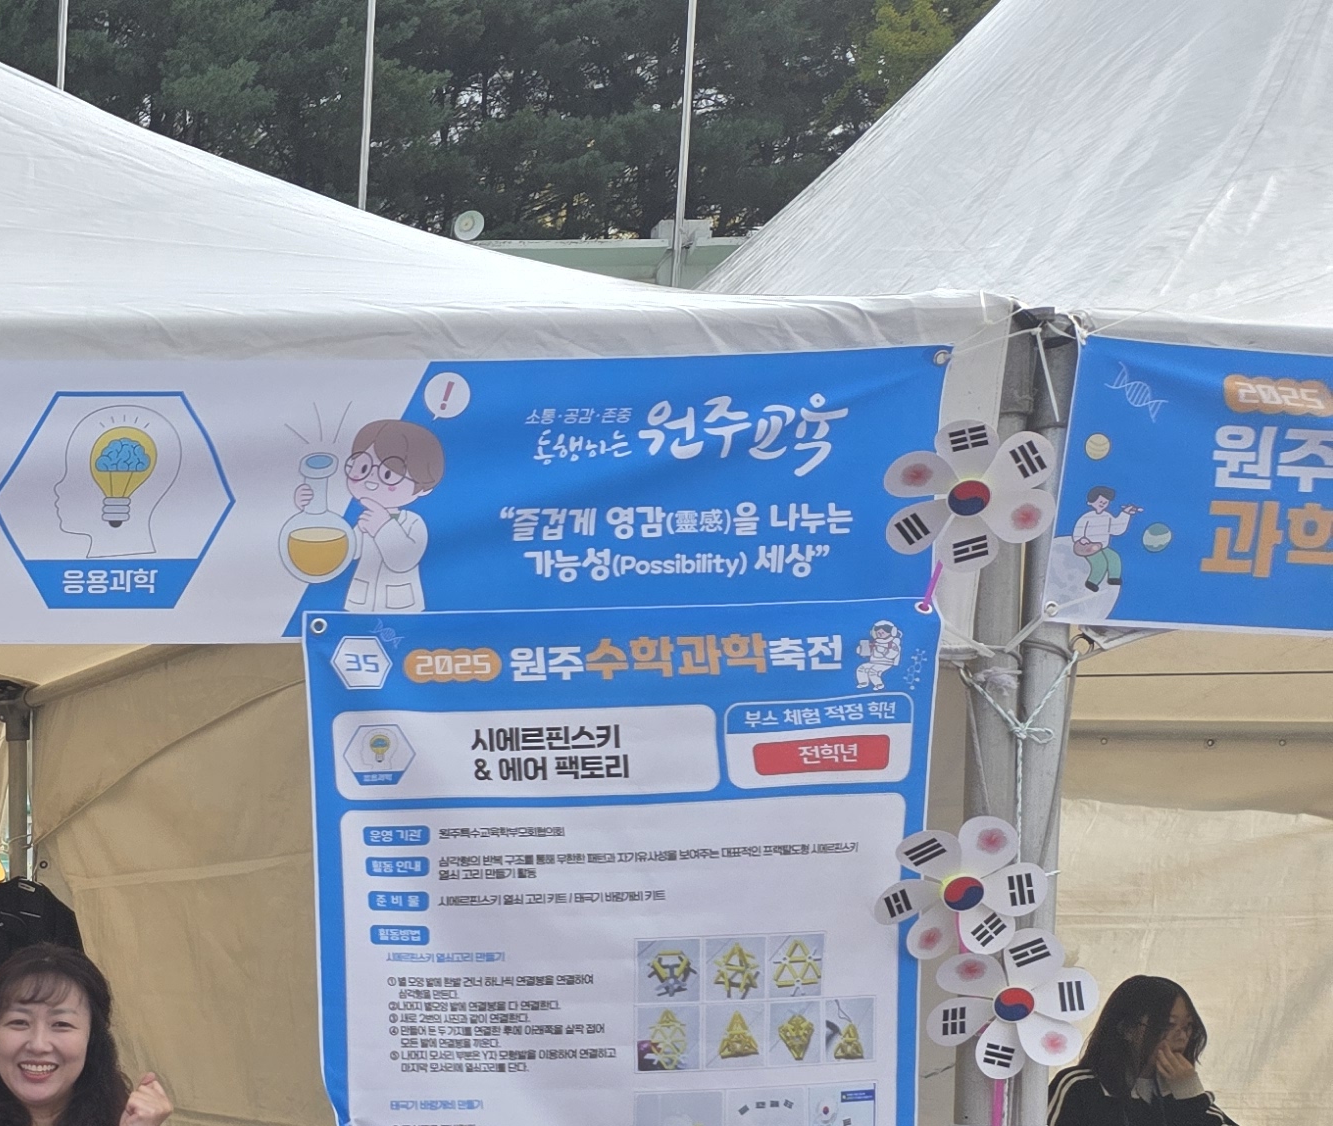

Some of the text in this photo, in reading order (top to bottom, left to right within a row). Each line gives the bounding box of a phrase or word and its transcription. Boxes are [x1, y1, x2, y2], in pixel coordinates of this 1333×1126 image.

[1235, 381, 1326, 410] 2025
[638, 393, 849, 478] 원주교육
[770, 503, 854, 535] 나누는
[524, 548, 748, 582] 가능성(Possibility)
[61, 566, 157, 596] 응용과학
[345, 653, 380, 673] 35
[415, 654, 491, 675] 2025
[744, 701, 896, 728] 부스 체험 적정 학년
[471, 724, 620, 752] 시에르핀스키
[799, 743, 857, 764] 전학년
[474, 754, 629, 781] & 에어 팩토리
[370, 830, 393, 842] 운영
[395, 829, 422, 842] 기관
[396, 861, 421, 873] 안내
